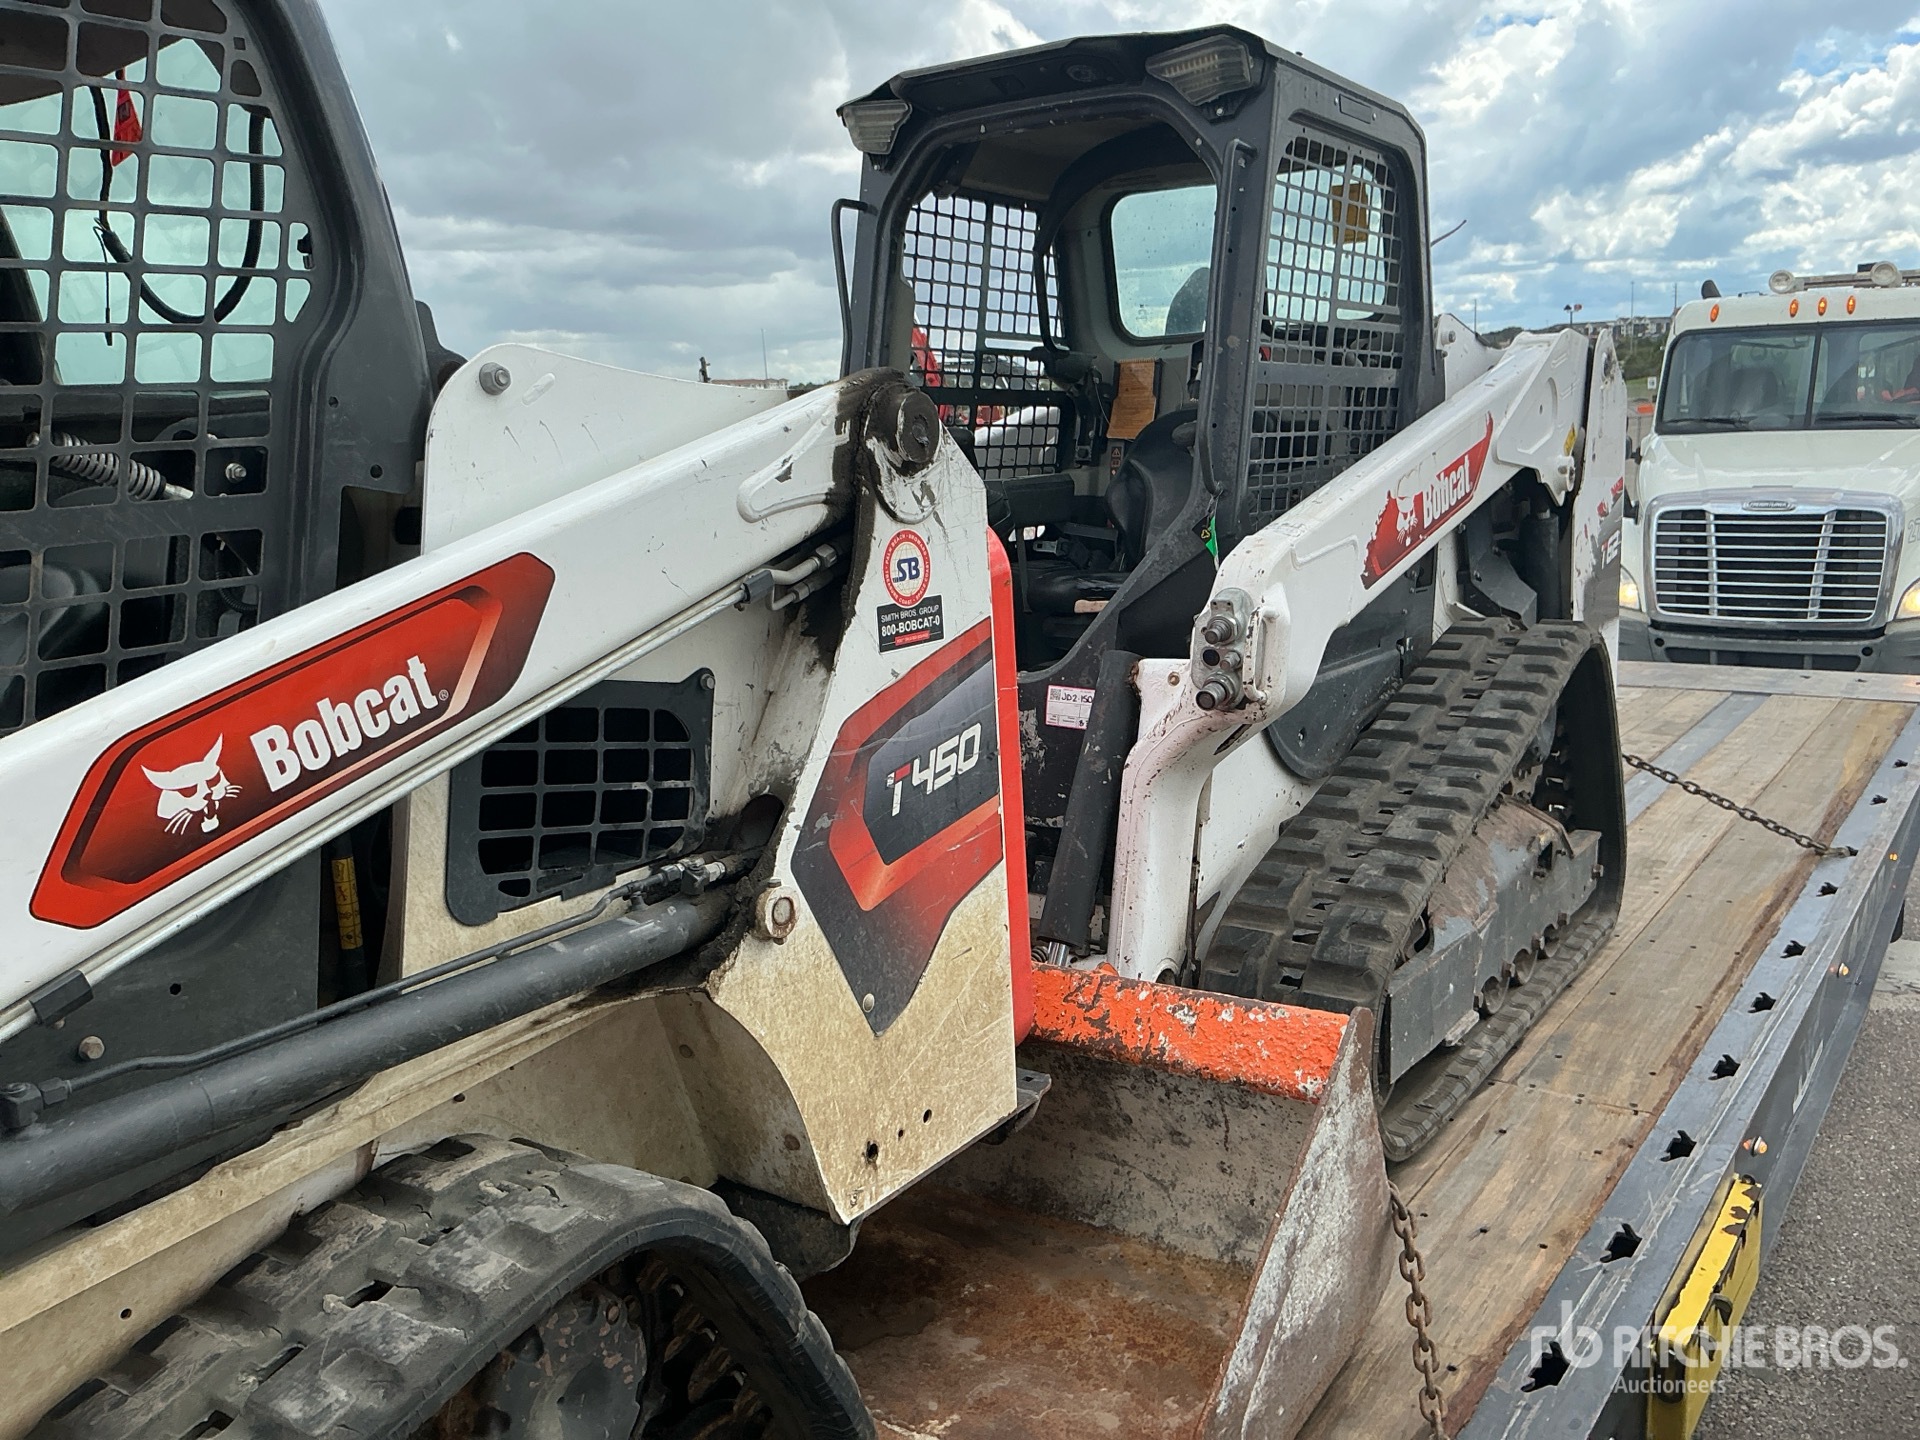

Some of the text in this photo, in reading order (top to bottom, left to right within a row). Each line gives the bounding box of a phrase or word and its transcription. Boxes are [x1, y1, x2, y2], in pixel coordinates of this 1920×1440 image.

[1422, 454, 1469, 529] Bobcat
[881, 604, 940, 623] SMITH BROS. GROUP
[881, 615, 940, 637] 800-BOBCAT-0
[249, 655, 438, 793] Bobcat
[887, 723, 981, 817] T450
